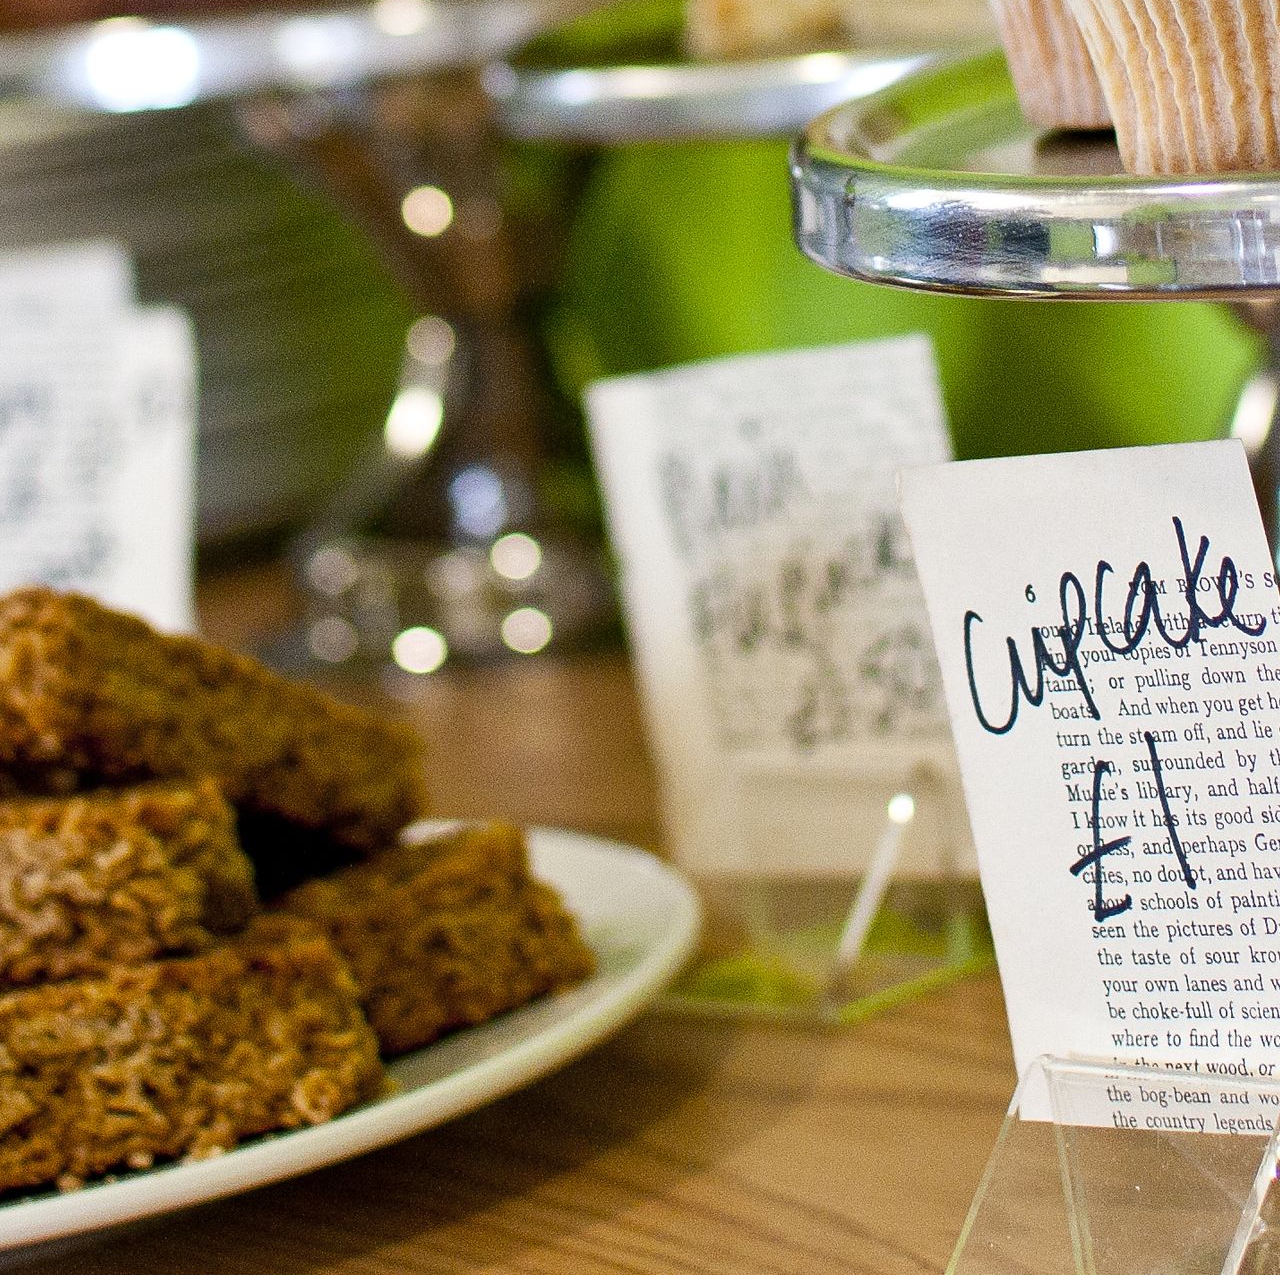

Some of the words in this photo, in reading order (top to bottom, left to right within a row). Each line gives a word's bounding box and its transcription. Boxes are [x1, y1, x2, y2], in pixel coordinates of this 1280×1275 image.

[1025, 584, 1036, 603] 6
[965, 516, 1268, 735] Cupcake
[1081, 649, 1118, 669] your
[1199, 639, 1277, 660] Tennyson
[1109, 677, 1124, 690] or
[1134, 669, 1190, 693] pulling
[1201, 667, 1247, 685] down
[1118, 698, 1151, 717] And
[1156, 696, 1200, 716] when
[1203, 698, 1234, 718] you
[1238, 695, 1264, 716] get
[1056, 731, 1091, 748] turn
[1097, 728, 1124, 746] the
[1129, 726, 1178, 745] stam
[1183, 723, 1212, 744] off,
[1216, 723, 1248, 741] and
[1253, 721, 1273, 739] lie
[1061, 756, 1122, 780] gardn,
[1132, 751, 1224, 773] surounded
[1235, 749, 1257, 772] by
[1066, 782, 1129, 802] Muie's
[1137, 780, 1199, 804] libary,
[1207, 778, 1238, 797] and
[1070, 811, 1080, 830] I
[1133, 809, 1147, 827] it
[1186, 808, 1207, 826] its
[1214, 806, 1254, 829] good
[1143, 837, 1174, 855] and
[1180, 838, 1247, 860] perhaps
[1082, 866, 1129, 886] ciies,
[1134, 869, 1152, 883] no
[1216, 863, 1247, 881] and
[1140, 892, 1199, 911] schools
[1206, 891, 1223, 909] of
[1091, 923, 1126, 939] seen
[1133, 920, 1159, 938] the
[1166, 920, 1233, 942] pictures
[1240, 917, 1256, 936] of
[1097, 948, 1123, 966] the
[1131, 947, 1171, 965] taste
[1180, 946, 1196, 964] of
[1205, 951, 1240, 965] sour
[1103, 979, 1138, 997] your
[1145, 979, 1179, 992] own
[1184, 973, 1228, 992] lanes
[1234, 973, 1264, 992] and
[1107, 1001, 1126, 1020] be
[1132, 1000, 1213, 1020] choke-full
[1219, 1001, 1234, 1020] of
[1111, 1028, 1158, 1048] where
[1167, 1031, 1181, 1048] to
[1189, 1028, 1220, 1048] find
[1227, 1028, 1252, 1048] the
[1258, 1062, 1275, 1076] or
[1107, 1085, 1132, 1103] the
[1139, 1086, 1211, 1108] bog-bean
[1220, 1091, 1250, 1104] and
[1112, 1110, 1137, 1129] the
[1145, 1114, 1205, 1134] country
[1213, 1112, 1275, 1135] legends
